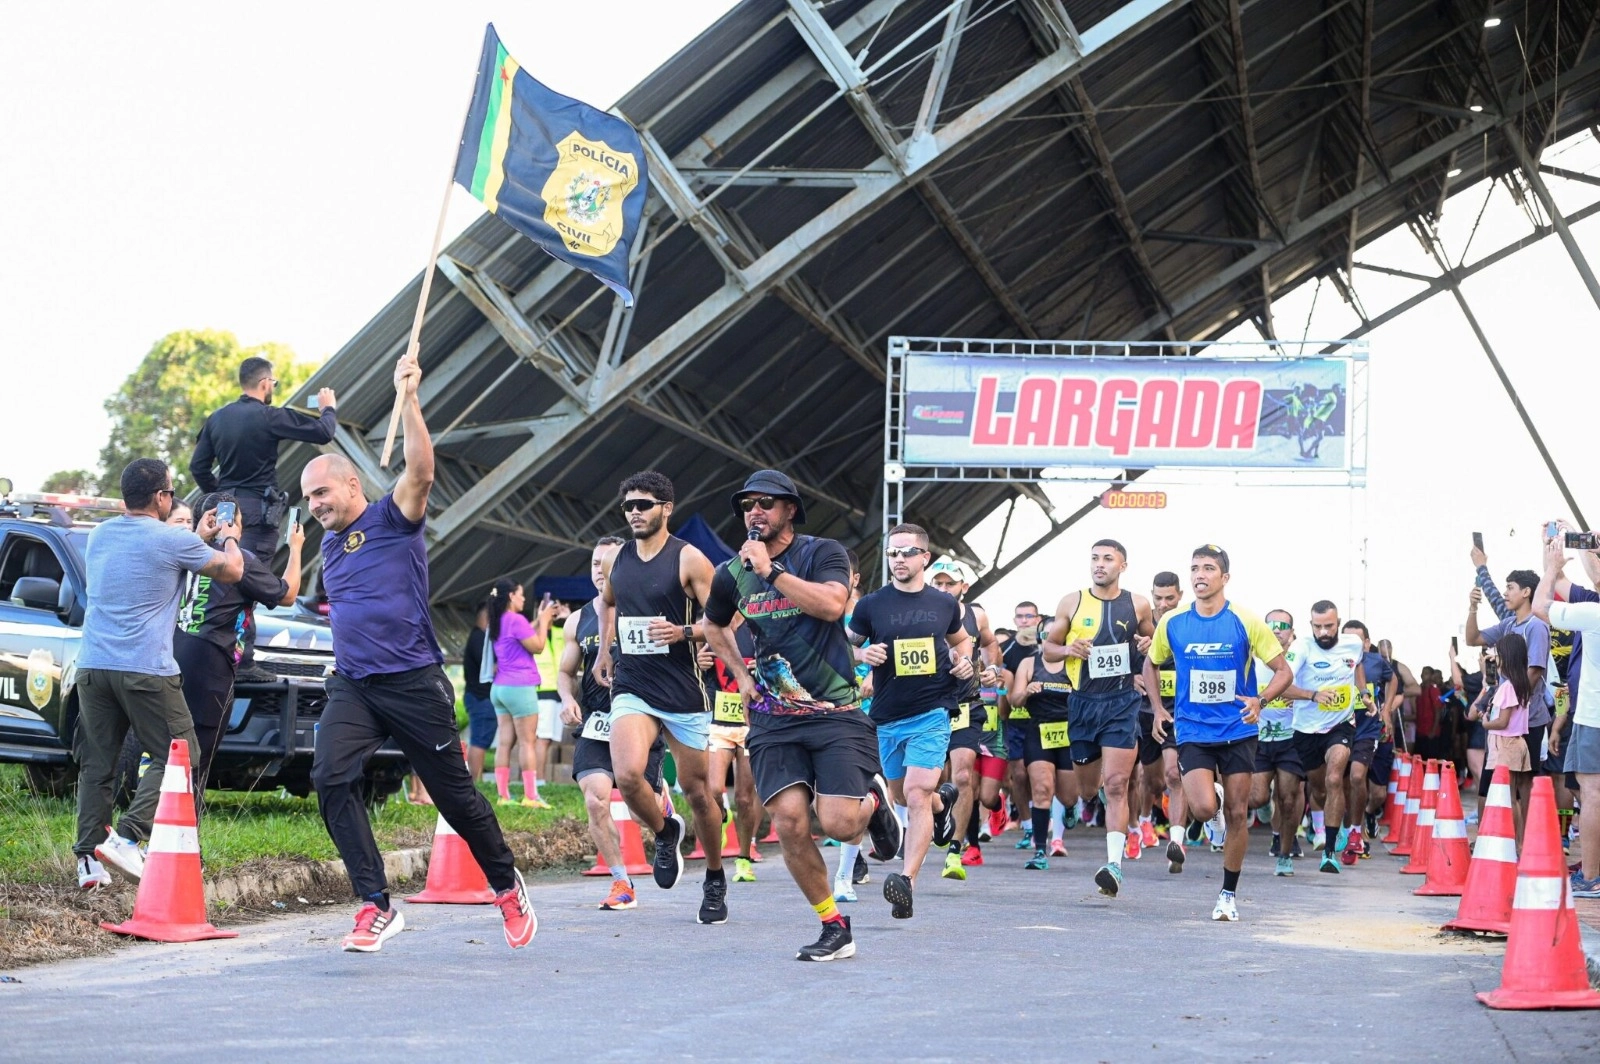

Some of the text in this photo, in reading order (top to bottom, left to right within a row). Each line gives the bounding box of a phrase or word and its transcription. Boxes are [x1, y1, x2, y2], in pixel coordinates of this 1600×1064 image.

[573, 144, 629, 178] POLÍCIA
[568, 240, 581, 250] AC
[972, 377, 1262, 455] LARGADA
[1108, 493, 1166, 507] 00:00:03
[627, 629, 655, 645] 41
[900, 649, 929, 666] 506
[1097, 654, 1122, 668] 249
[1199, 681, 1226, 694] 398
[722, 701, 744, 714] 578
[594, 719, 610, 733] 05
[1044, 730, 1065, 741] 477
